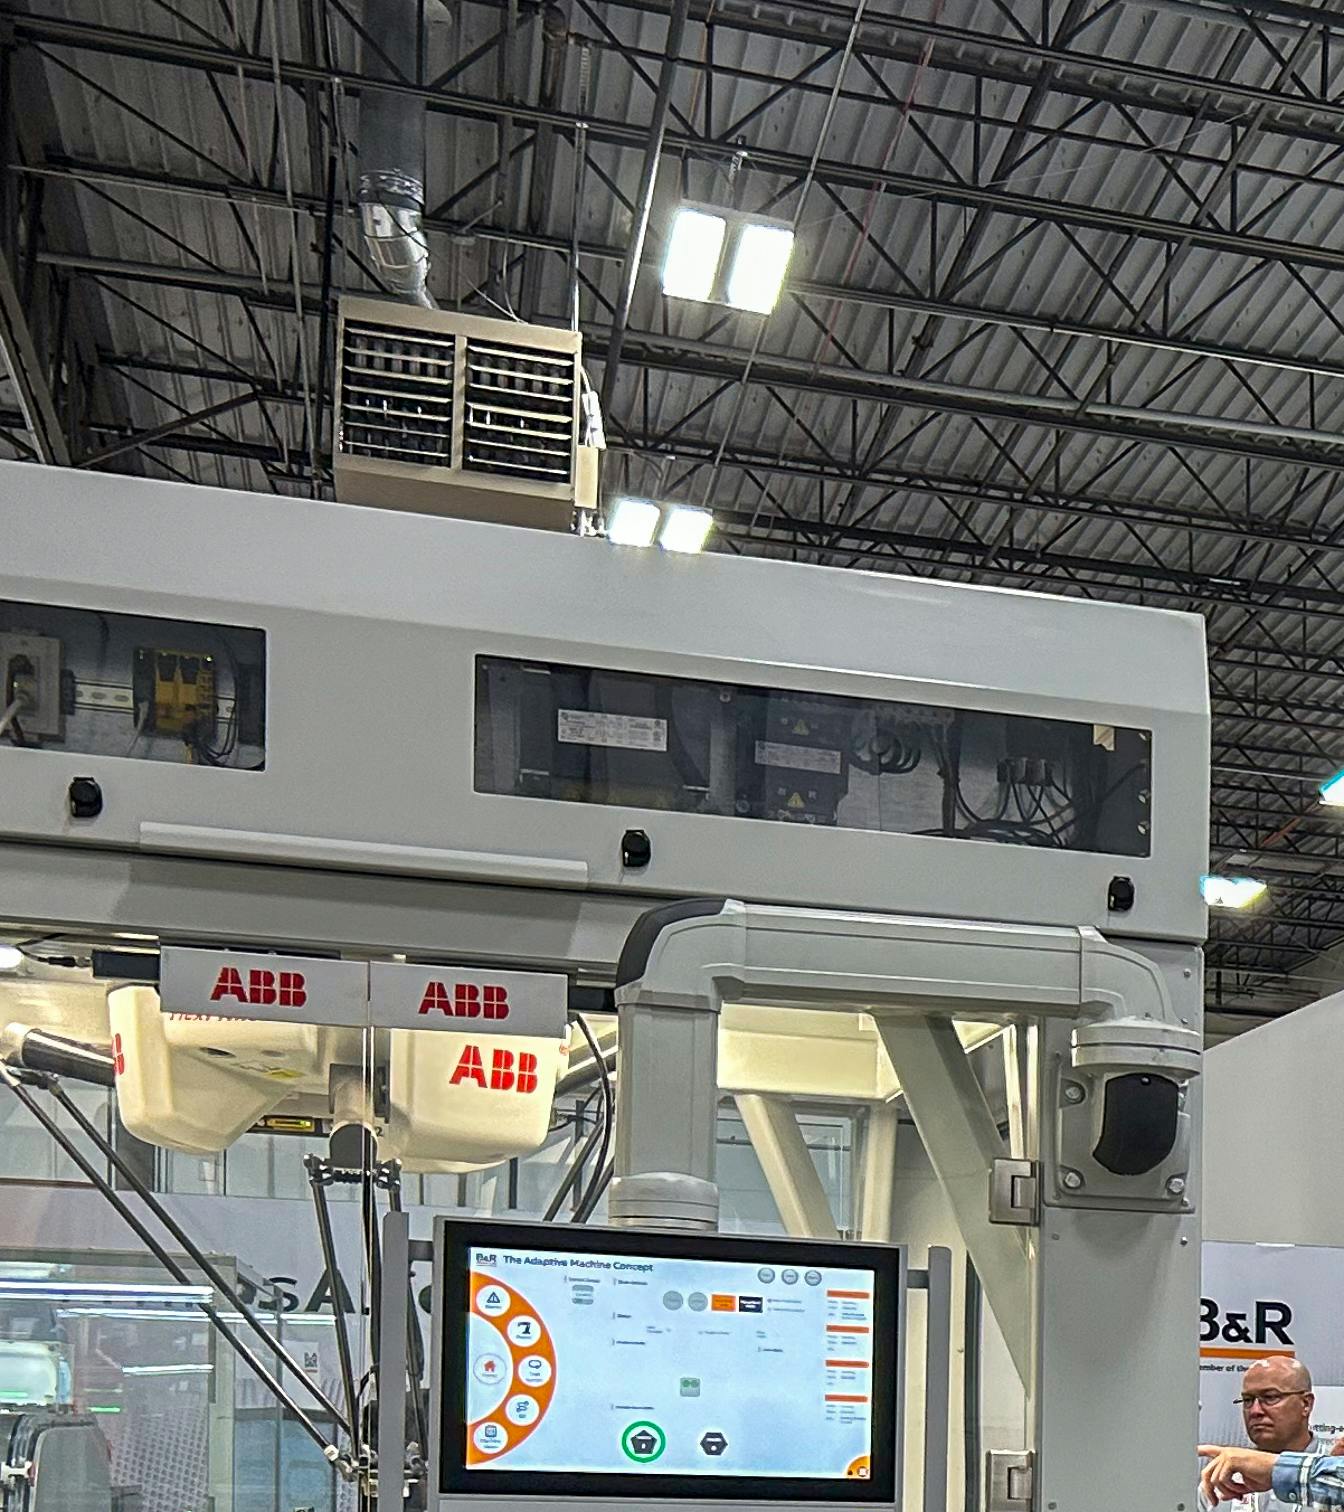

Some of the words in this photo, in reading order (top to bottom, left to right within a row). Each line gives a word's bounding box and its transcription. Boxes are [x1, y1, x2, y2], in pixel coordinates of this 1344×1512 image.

[210, 966, 308, 1008] ABB
[417, 981, 511, 1020] ABB
[448, 1044, 539, 1094] ABB
[503, 1255, 521, 1264] The
[524, 1257, 568, 1267] Adaptive
[570, 1260, 612, 1270] Machine
[613, 1261, 654, 1273] Concept
